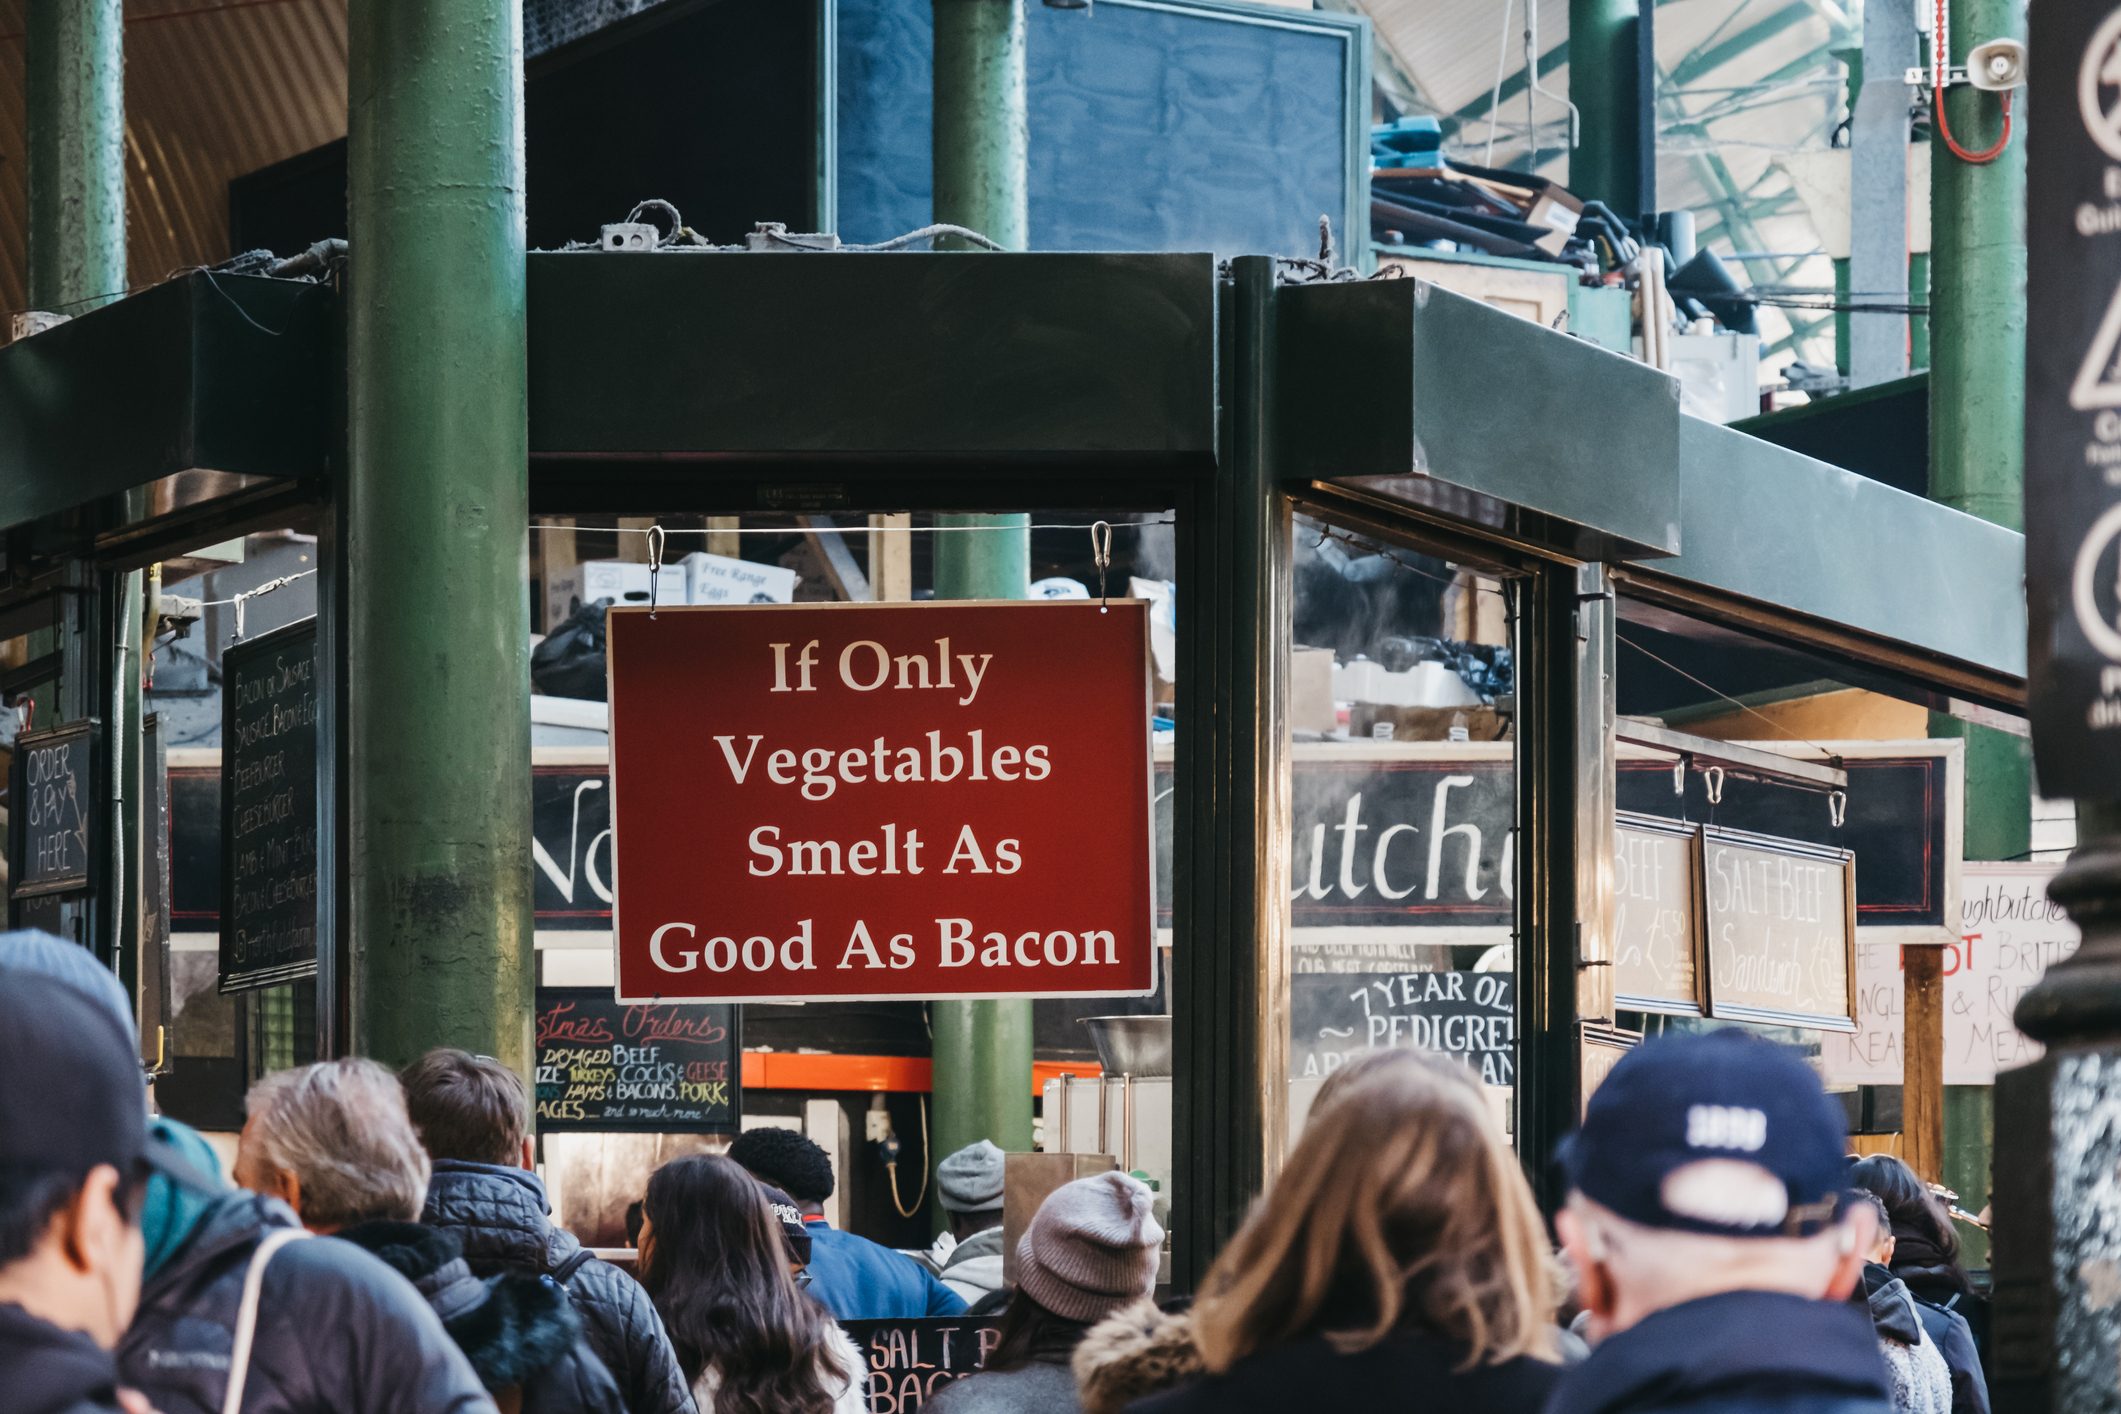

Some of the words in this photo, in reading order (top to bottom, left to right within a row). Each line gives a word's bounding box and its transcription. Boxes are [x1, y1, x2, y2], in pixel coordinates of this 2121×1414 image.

[700, 582, 729, 599] Eggs
[701, 561, 727, 578] Free
[730, 567, 768, 586] Range
[770, 640, 820, 692] If
[839, 638, 993, 706] Only
[27, 744, 71, 786] ORDER
[713, 729, 1052, 801] Vegetables
[29, 788, 40, 826] &
[43, 784, 67, 827] PAY
[38, 829, 71, 873] HERE
[749, 823, 925, 877] Smelt
[943, 825, 1022, 875] As
[1714, 848, 1773, 915] SALT
[1779, 857, 1826, 923] BEEF
[650, 919, 818, 973] Good
[837, 920, 916, 970] As
[935, 918, 1120, 968] Bacon
[1719, 922, 1816, 1010] Sandwich
[1350, 986, 1371, 1018] 7
[1373, 973, 1467, 1009] YEAR
[1473, 976, 1513, 1015] OL
[1952, 991, 1975, 1016] &
[623, 1004, 727, 1046] Orders
[613, 1044, 661, 1066] BEEF
[621, 1061, 676, 1084] COCKS
[686, 1060, 729, 1082] GEESE
[564, 1083, 605, 1101] HAMS
[870, 1327, 961, 1371] SALT
